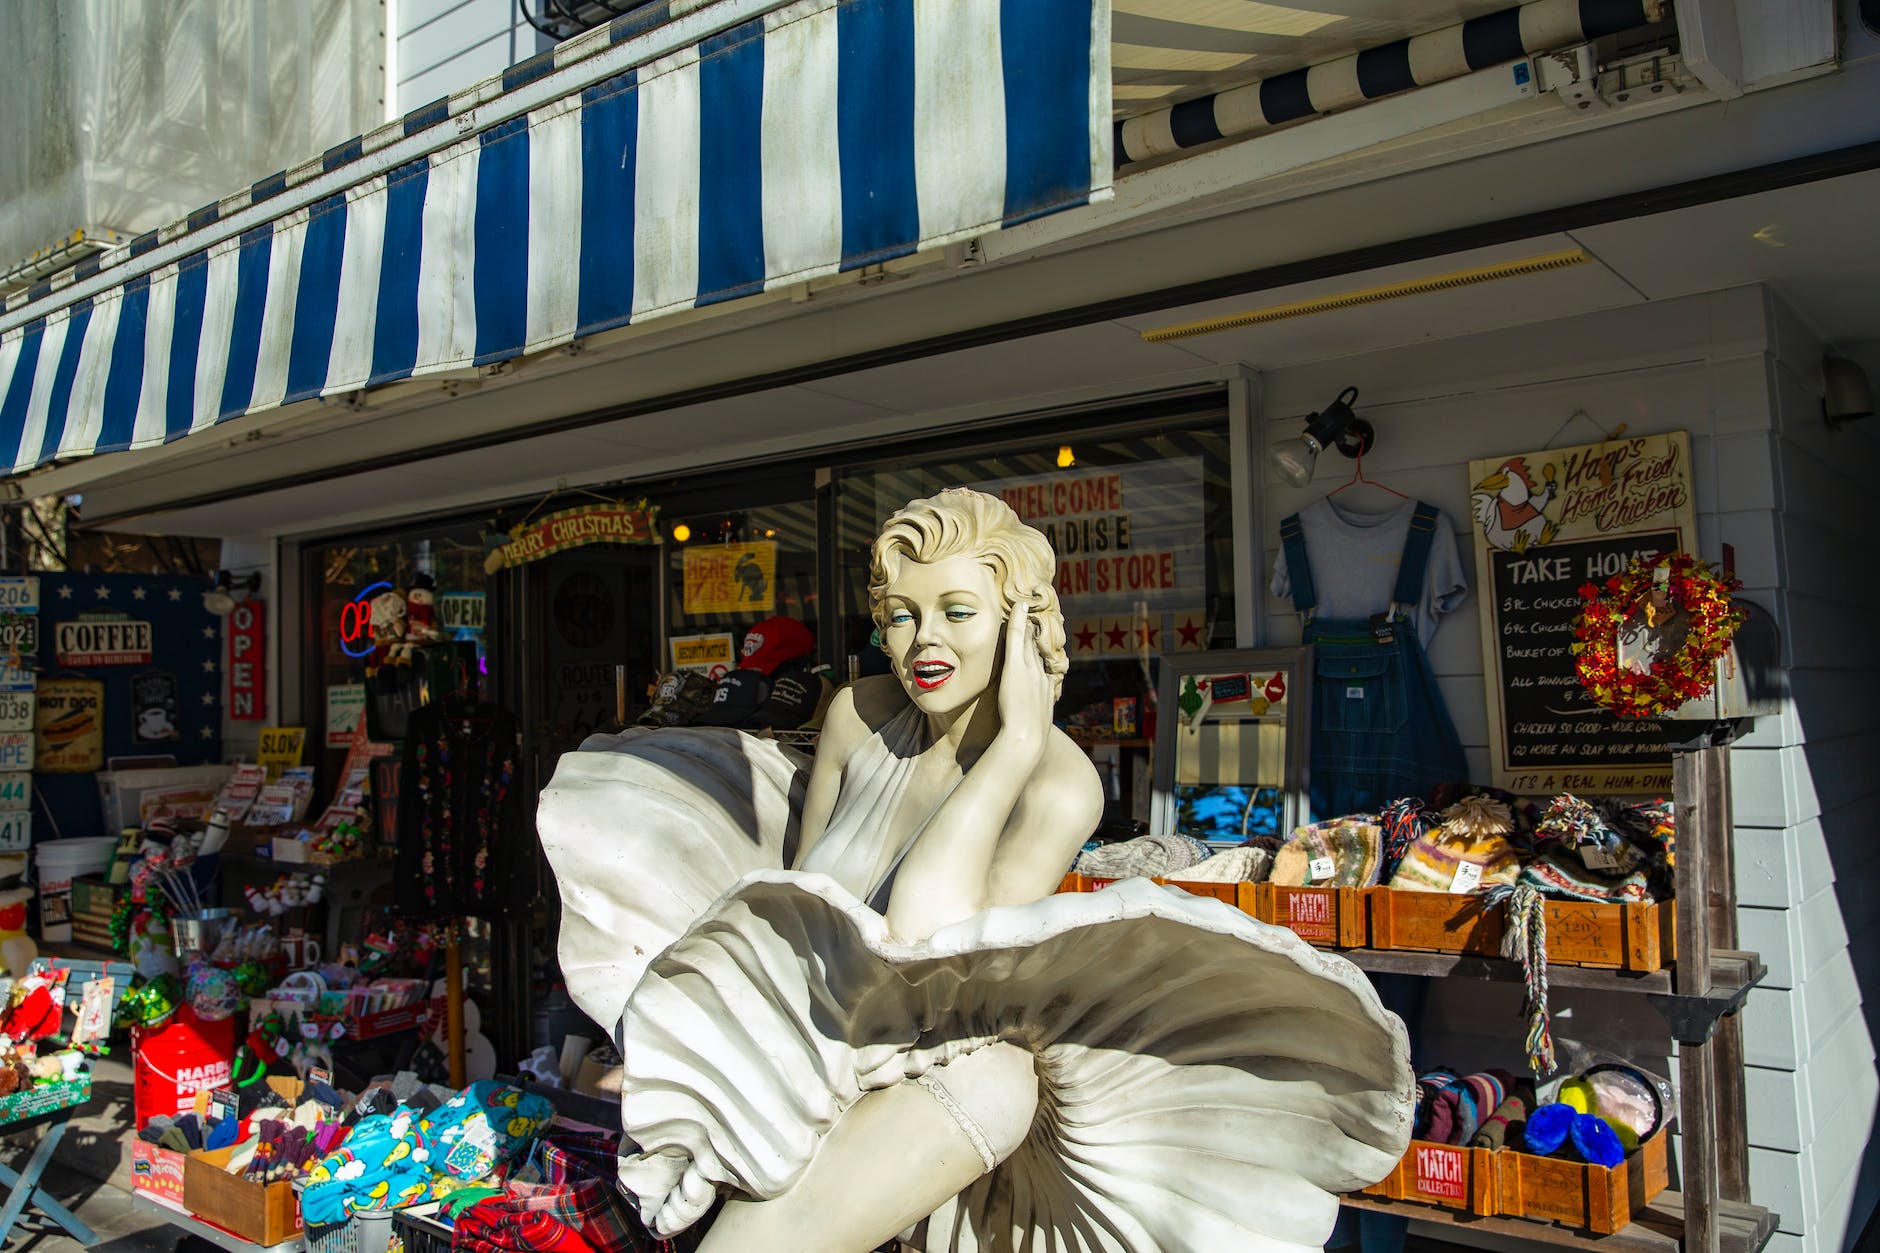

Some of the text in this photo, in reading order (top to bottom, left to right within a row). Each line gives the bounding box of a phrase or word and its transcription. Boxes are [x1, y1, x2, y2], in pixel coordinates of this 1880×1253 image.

[1561, 446, 1676, 522] Home Fried
[1001, 476, 1120, 519] WELCOME
[1598, 487, 1680, 530] Chicken
[503, 514, 634, 560] MERRY CHRISTMAS
[687, 556, 728, 581] HERE
[1097, 553, 1172, 592] STORE
[1506, 556, 1571, 585] TAKE
[711, 580, 728, 602] IS
[1533, 596, 1580, 609] CHICKEN
[444, 600, 482, 627] OPEN
[61, 625, 148, 651] COFFEE
[233, 607, 253, 716] OPEN
[1506, 645, 1546, 658] BUCKET
[1547, 648, 1566, 657] OF
[1510, 676, 1534, 687] ALL
[40, 697, 97, 708] HOT DOG
[1513, 722, 1556, 734] CHICKEN
[1558, 721, 1572, 734] SO
[1574, 721, 1601, 735] GOOD
[1512, 745, 1527, 757] GO
[1529, 744, 1558, 755] HOME
[1560, 744, 1577, 755] AN
[1511, 776, 1538, 790] IT'S
[1543, 774, 1560, 790] A
[1562, 775, 1595, 788] REAL
[1289, 893, 1329, 922] MATCH
[1416, 1147, 1462, 1183] MATCH
[1417, 1179, 1464, 1198] COLLECTION
